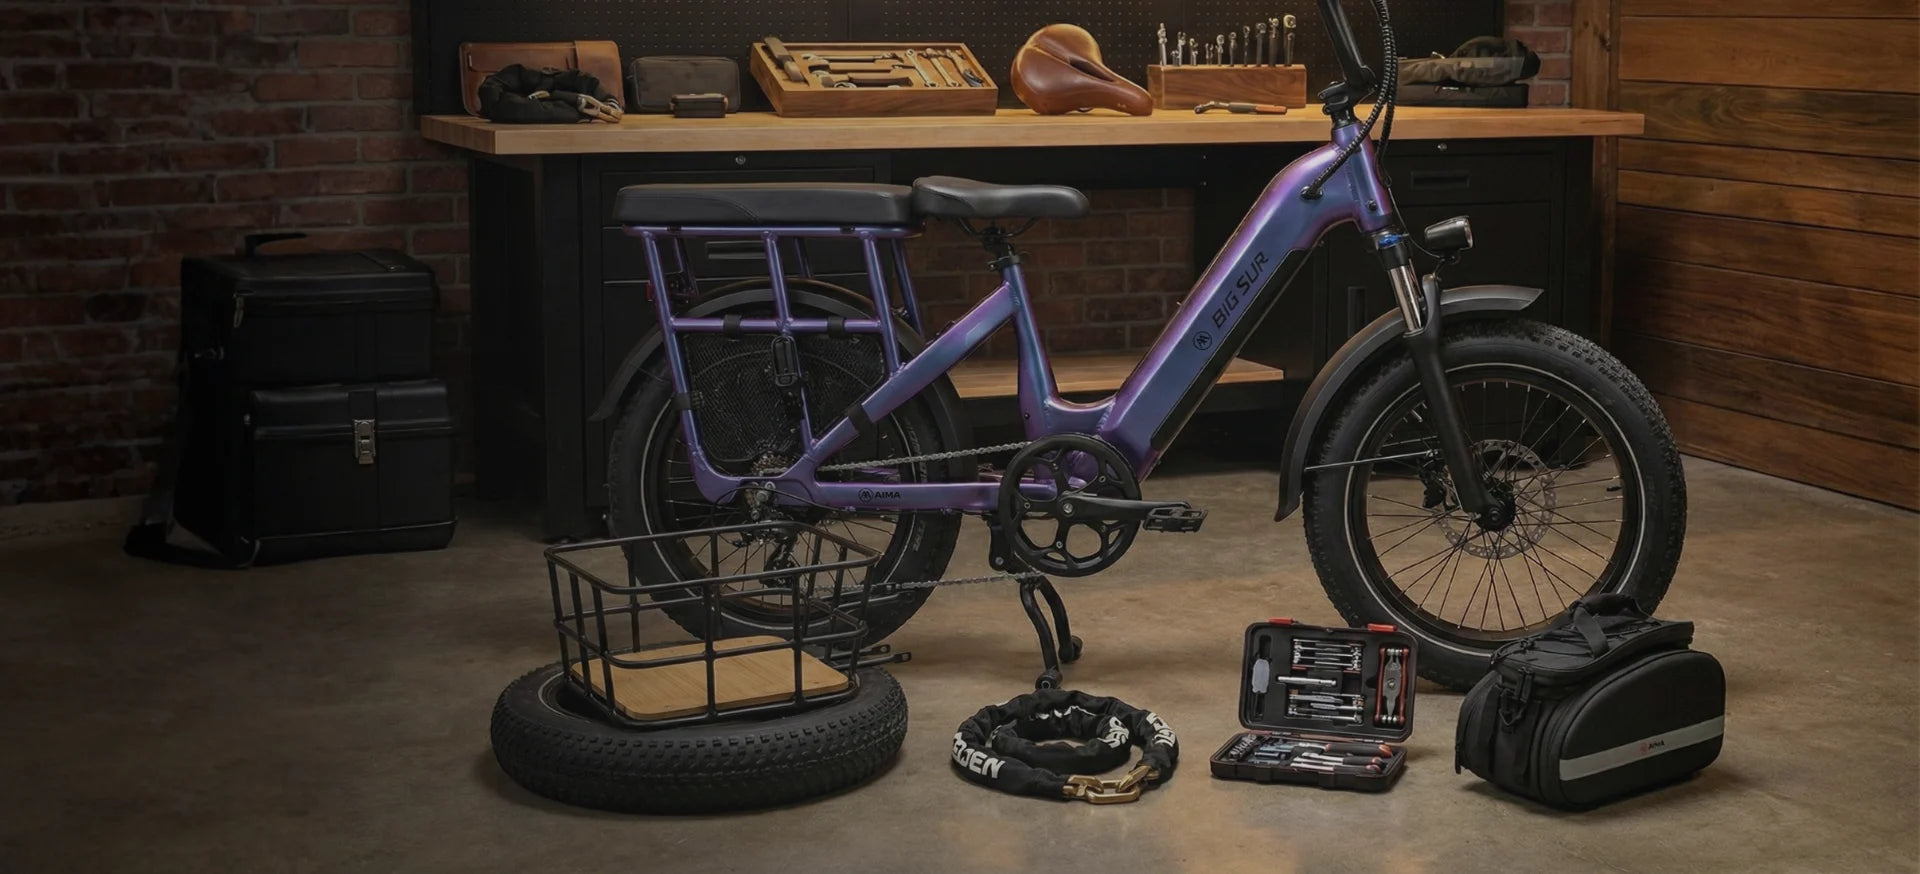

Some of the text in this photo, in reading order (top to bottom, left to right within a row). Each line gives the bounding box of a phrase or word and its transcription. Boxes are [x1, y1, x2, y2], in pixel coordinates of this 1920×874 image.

[1212, 251, 1269, 328] BIG SUR
[874, 491, 901, 499] AIMA
